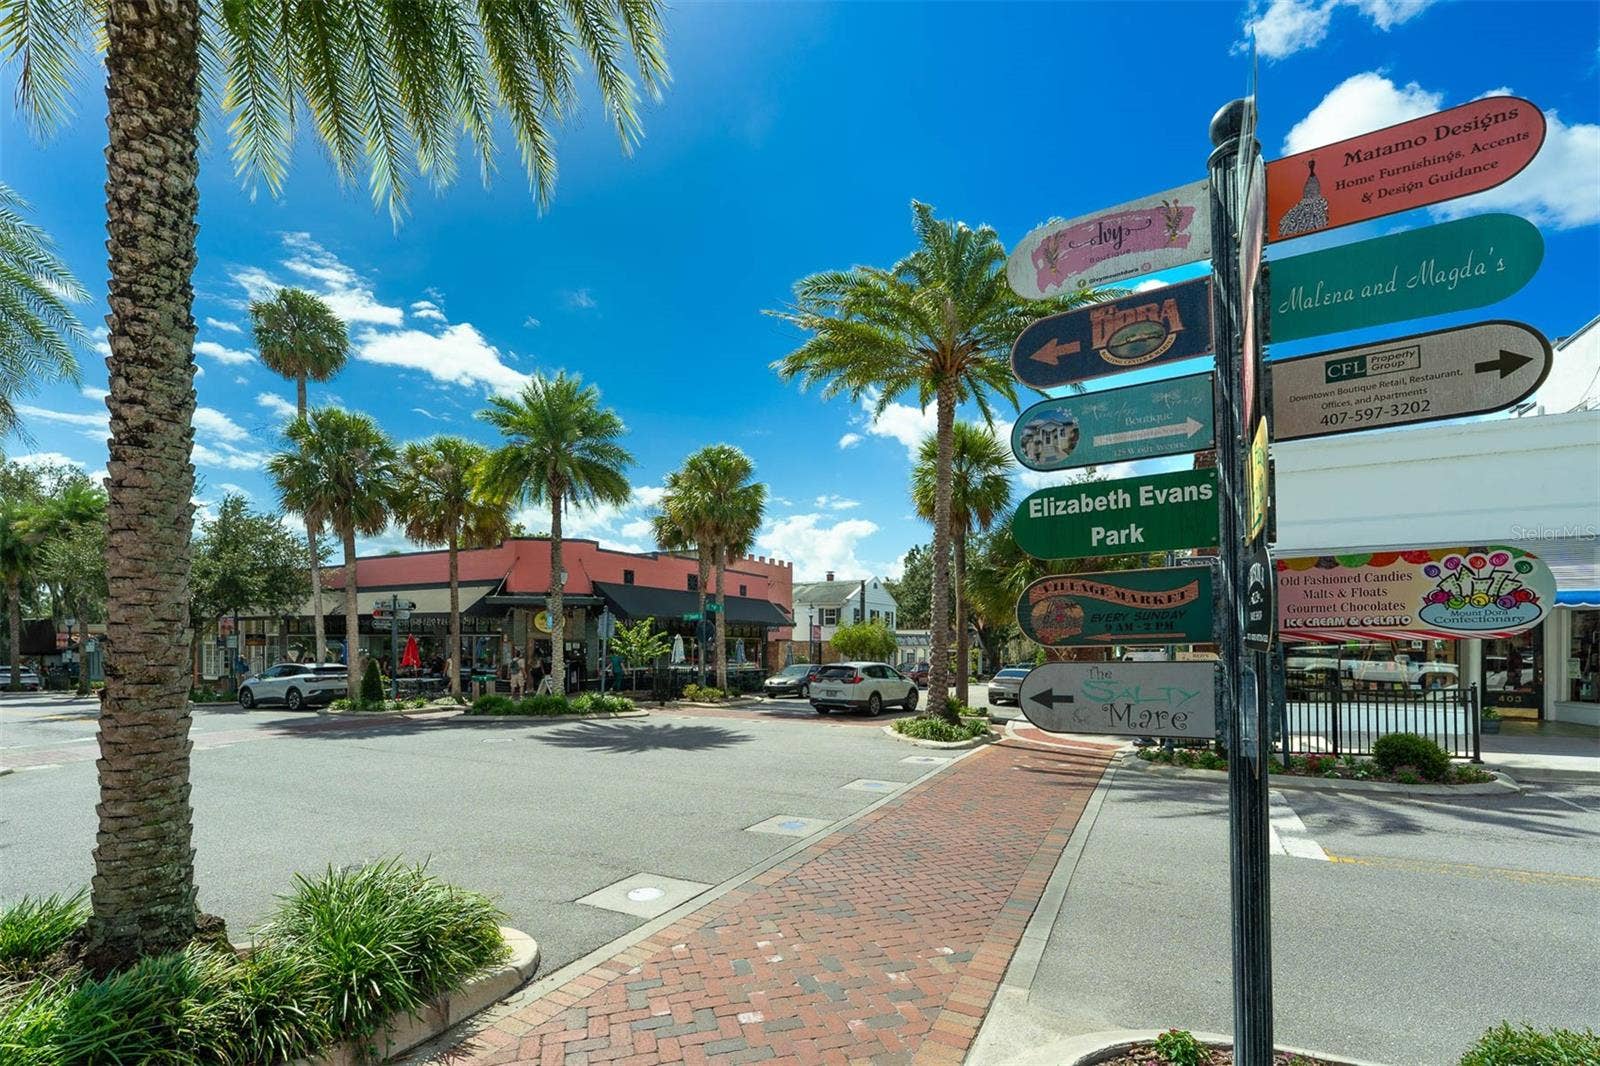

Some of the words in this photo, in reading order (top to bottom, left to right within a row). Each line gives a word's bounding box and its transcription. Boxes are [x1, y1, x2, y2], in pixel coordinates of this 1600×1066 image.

[1343, 134, 1427, 167] Matamo
[1434, 107, 1520, 141] Designs
[1335, 174, 1375, 191] Home
[1470, 131, 1530, 155] Accents
[1361, 192, 1374, 204] &
[1377, 180, 1424, 199] Design
[1428, 159, 1499, 186] Guidance
[1090, 249, 1132, 264] Boutique
[1278, 280, 1354, 314] Malena
[1361, 265, 1398, 297] and
[1406, 246, 1506, 290] Magda's
[1370, 349, 1416, 364] Property
[1327, 361, 1366, 378] CFL
[1370, 360, 1405, 372] Group
[1289, 388, 1336, 403] Downtown
[1337, 382, 1378, 396] Boutique
[1379, 377, 1408, 389] Retail,
[1321, 400, 1353, 410] Offices,
[1354, 395, 1371, 405] and
[1373, 386, 1428, 402] Apartments
[1125, 412, 1173, 425] Boutique
[1320, 399, 1431, 426] 407-597-3202
[1029, 489, 1131, 518] Elizabeth
[1139, 483, 1213, 507] Evans
[1091, 523, 1144, 547] Park
[1280, 576, 1300, 587] Old
[1303, 573, 1361, 586] Fashioned
[1364, 570, 1413, 583] Candies
[1043, 580, 1110, 596] VILLAGE
[1114, 589, 1188, 605] MARKET
[1303, 588, 1334, 600] Malts
[1337, 588, 1347, 598] &
[1350, 587, 1388, 598] Floats
[1287, 602, 1337, 614] Gourmet
[1340, 601, 1406, 613] Chocolates
[1450, 610, 1481, 618] Mount
[1090, 612, 1128, 623] EVERY
[1134, 609, 1186, 621] SUNDAY
[1285, 617, 1304, 628] ICE
[1305, 617, 1345, 628] CREAM
[1348, 616, 1360, 627] &
[1362, 615, 1412, 626] GELATO
[1434, 614, 1525, 624] Confectionary
[1116, 622, 1133, 632] AM
[1155, 621, 1174, 631] PM
[1088, 666, 1112, 679] The
[1499, 695, 1522, 703] 403
[1102, 703, 1193, 730] Mare
